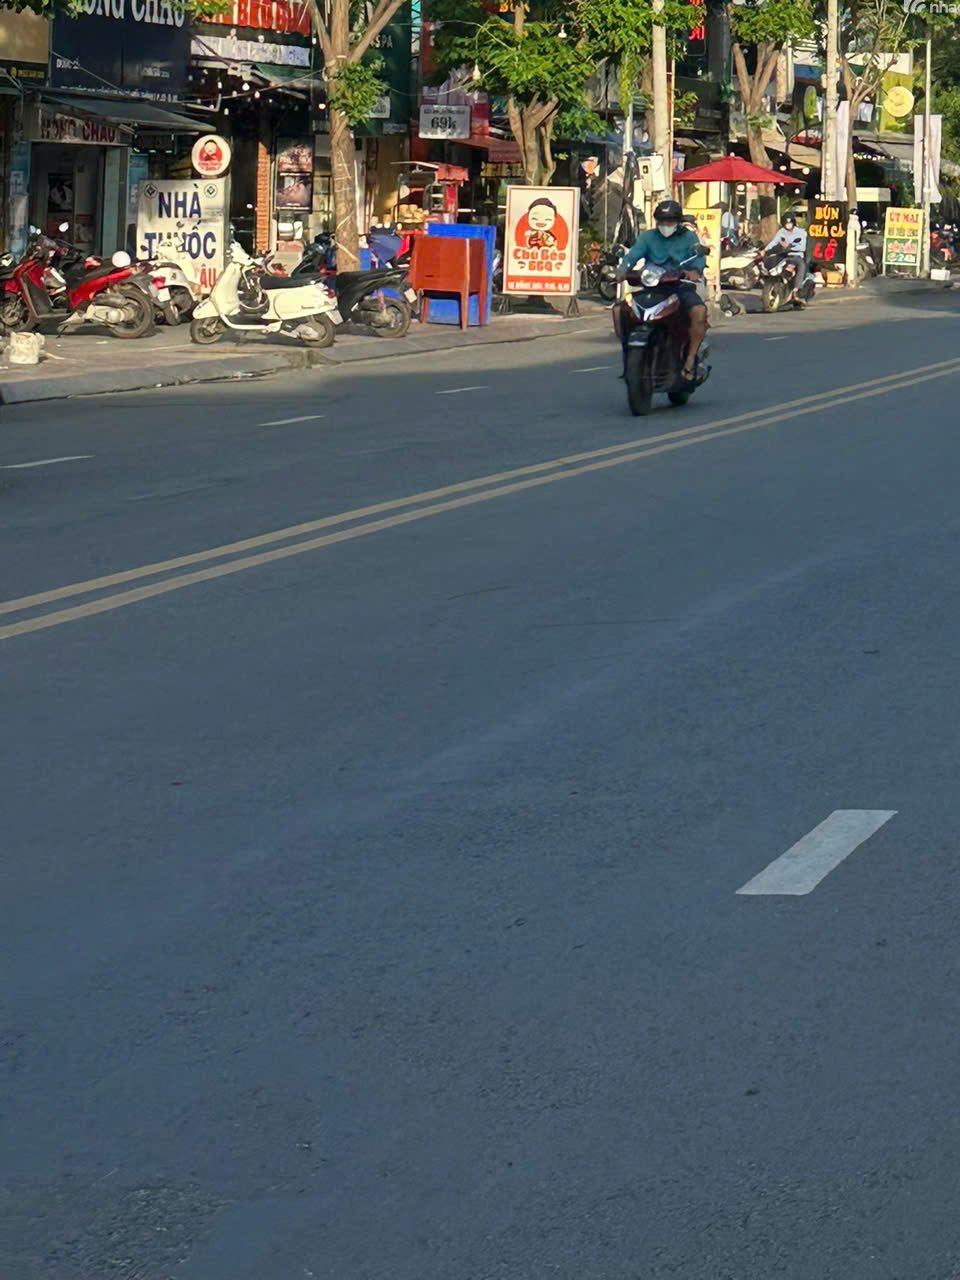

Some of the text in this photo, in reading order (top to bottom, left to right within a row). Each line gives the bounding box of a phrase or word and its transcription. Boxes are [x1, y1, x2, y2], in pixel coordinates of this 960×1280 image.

[158, 183, 202, 218] NHÀ
[815, 205, 839, 220] BÚN
[144, 220, 216, 260] TỐC
